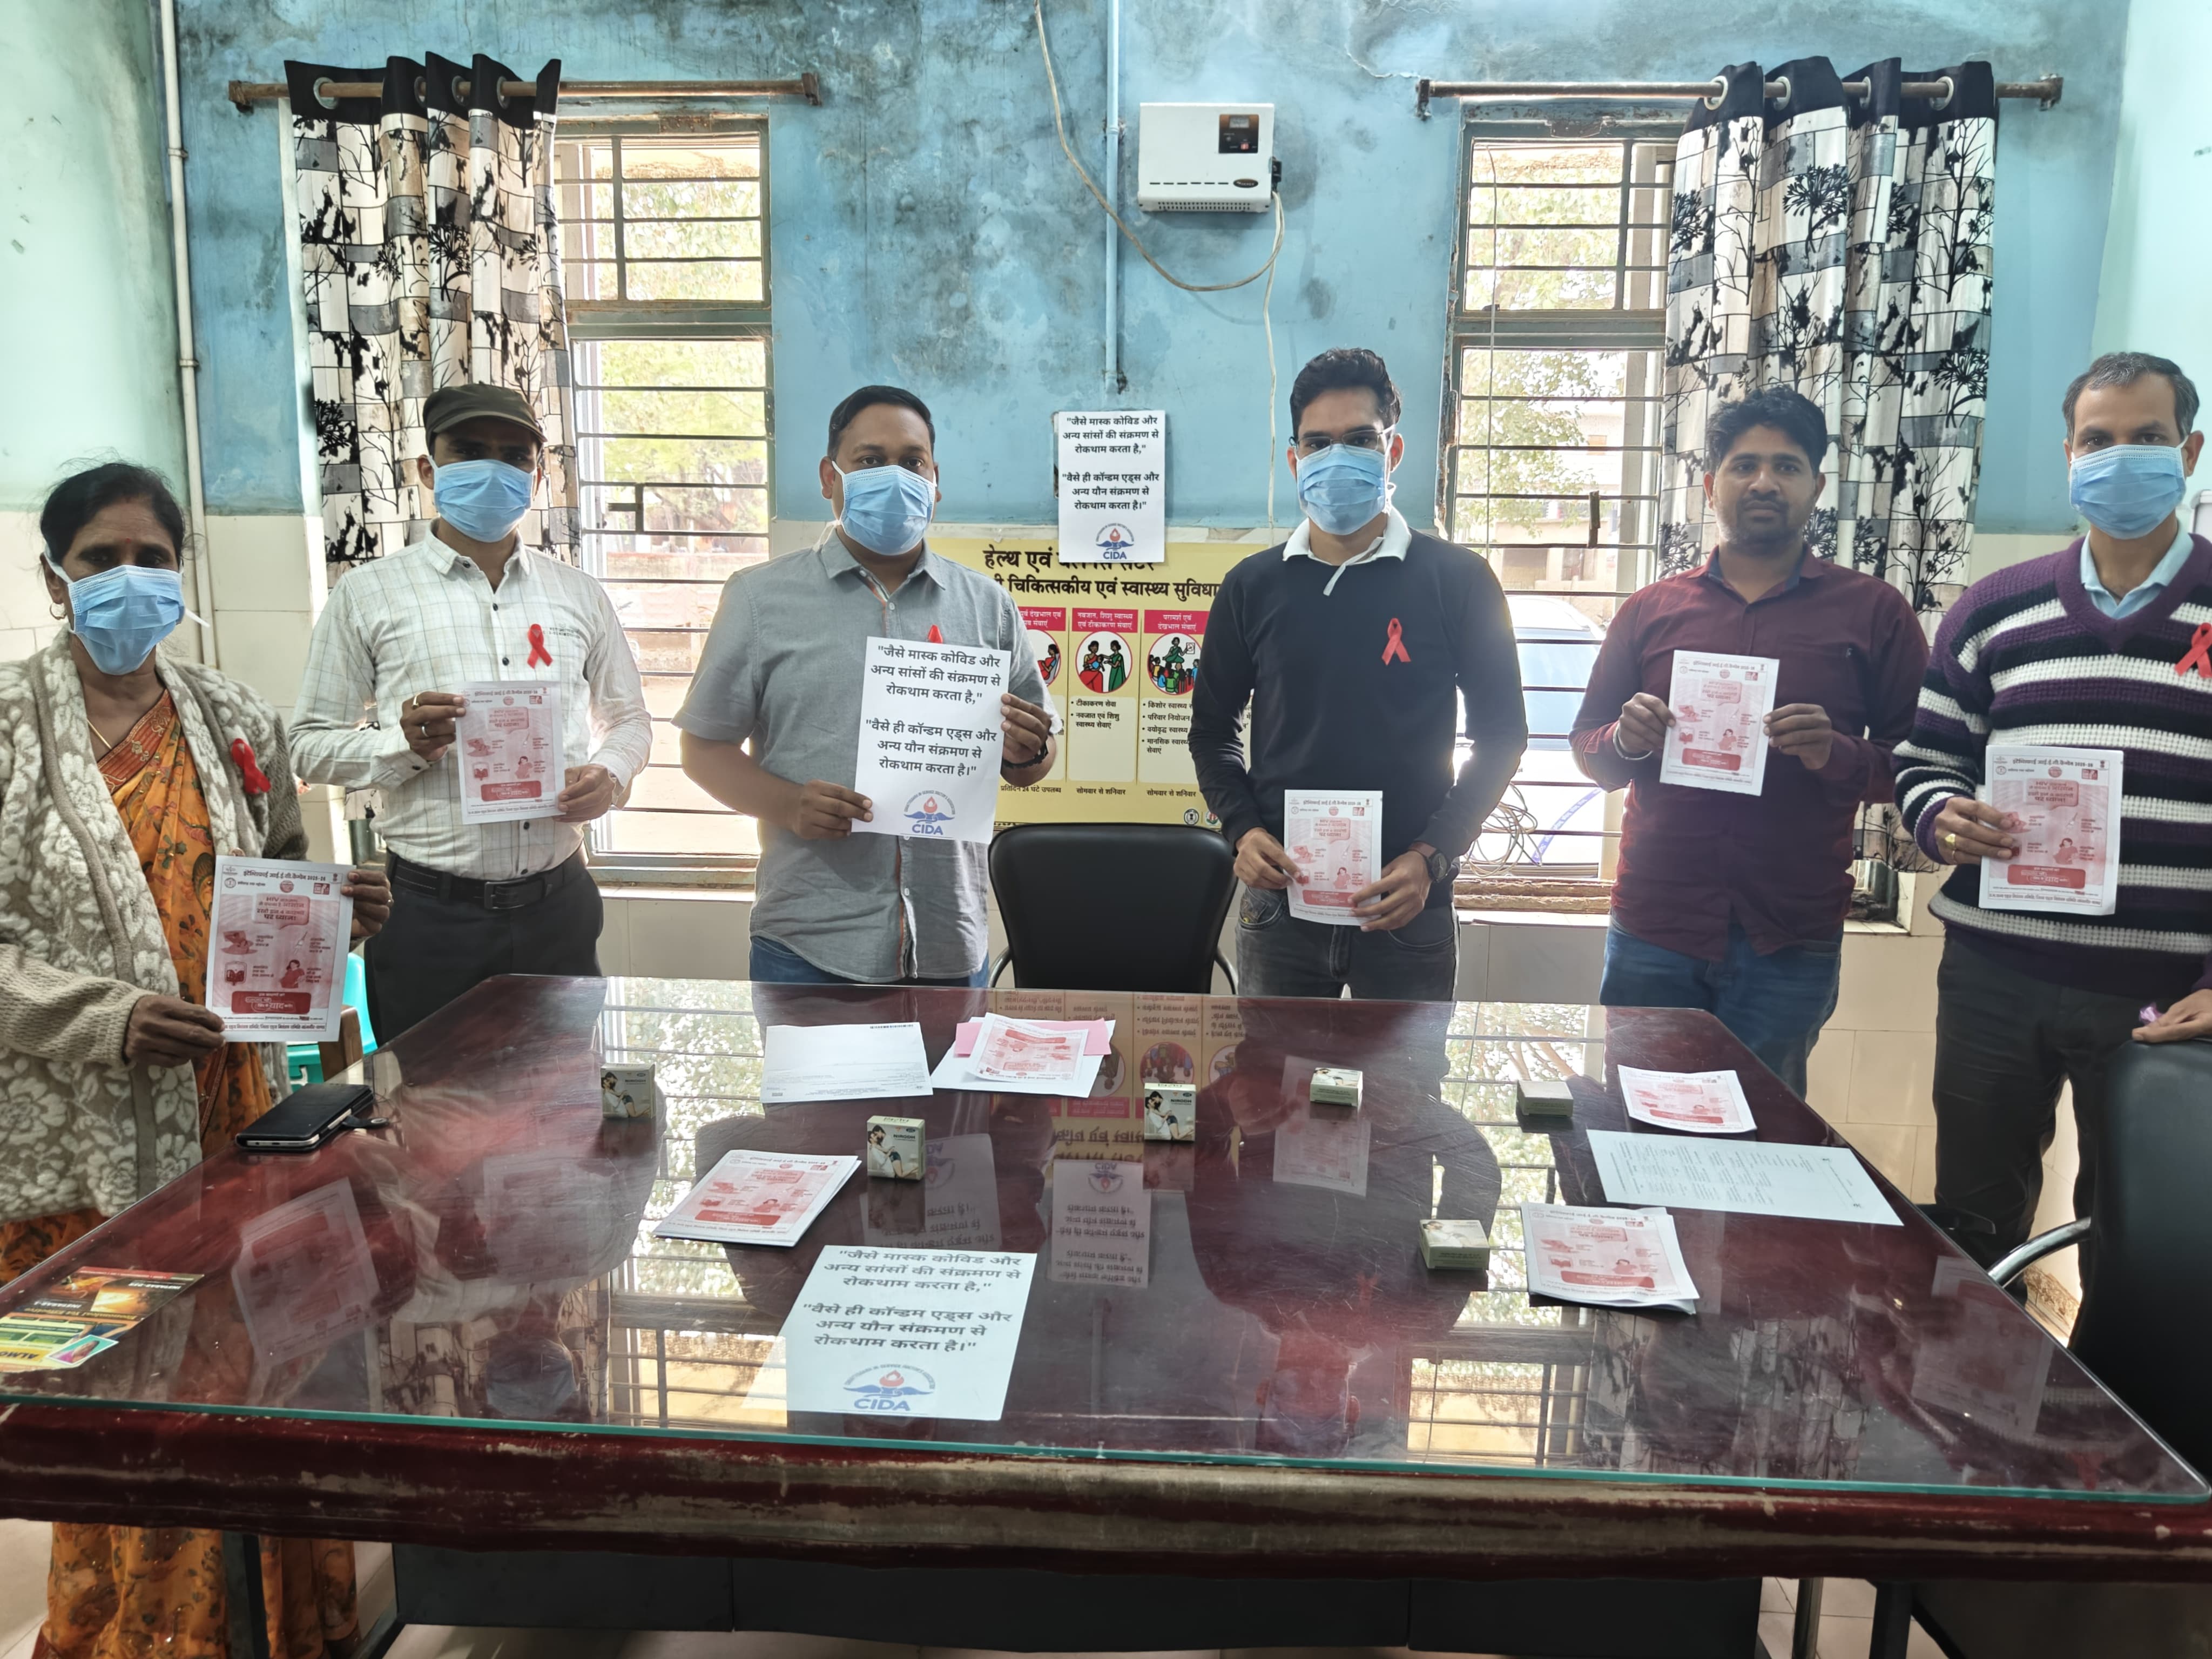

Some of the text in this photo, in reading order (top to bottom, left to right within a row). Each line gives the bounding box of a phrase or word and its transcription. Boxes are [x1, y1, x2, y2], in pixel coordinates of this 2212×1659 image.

[1067, 416, 1087, 425] "जैसे
[1113, 415, 1139, 424] कोविड
[1142, 416, 1157, 424] और
[1083, 430, 1103, 439] सांसों
[1106, 430, 1116, 439] की
[1119, 430, 1149, 439] संक्रमण
[1151, 429, 1159, 438] से
[1075, 444, 1107, 453] रोकथाम
[1133, 443, 1145, 454] है,"
[1063, 471, 1159, 483] "वैसे ही कॉन्डम एड्स और
[1092, 486, 1107, 495] यौन
[1109, 486, 1139, 495] संक्रमण
[1142, 485, 1149, 495] से
[1075, 500, 1106, 509] रोकथाम
[1132, 500, 1146, 510] है।"
[983, 544, 1022, 569] हेल्थ
[1024, 547, 1053, 573] एवं
[1103, 551, 1127, 559] CIDA
[1007, 574, 1092, 594] चिकित्सकीय
[1095, 577, 1117, 599] एवं
[1121, 582, 1170, 596] स्वास्थ्य
[1173, 578, 1220, 602] सुविधा
[879, 644, 1000, 667] "जैसे मास्क कोविड और
[871, 665, 1001, 686] अन्य सांसों की संक्रमण से
[886, 682, 982, 704] रोकथाम करता है,"
[1107, 711, 1120, 721] शिशु
[866, 718, 997, 741] "वैसे ही कॉन्डम एड्स और
[878, 740, 982, 758] अन्य यौन संक्रमण से
[879, 756, 976, 777] रोकथाम करता है।"
[912, 824, 943, 835] CIDA
[840, 1250, 878, 1259] "जैसे
[932, 1254, 984, 1263] कोविड
[990, 1256, 1021, 1265] और
[865, 1265, 907, 1273] सांसों
[912, 1266, 935, 1274] की
[940, 1267, 1001, 1277] संक्रमण
[1007, 1270, 1021, 1279] से
[844, 1276, 991, 1292] रोकथाम करता है,"
[804, 1303, 1012, 1322] "वैसे ही कॉन्डम एड्स और
[817, 1320, 987, 1336] अन्य यौन संक्रमण से
[814, 1334, 976, 1352] रोकथाम करता है।"
[854, 1399, 910, 1411] CIDA
